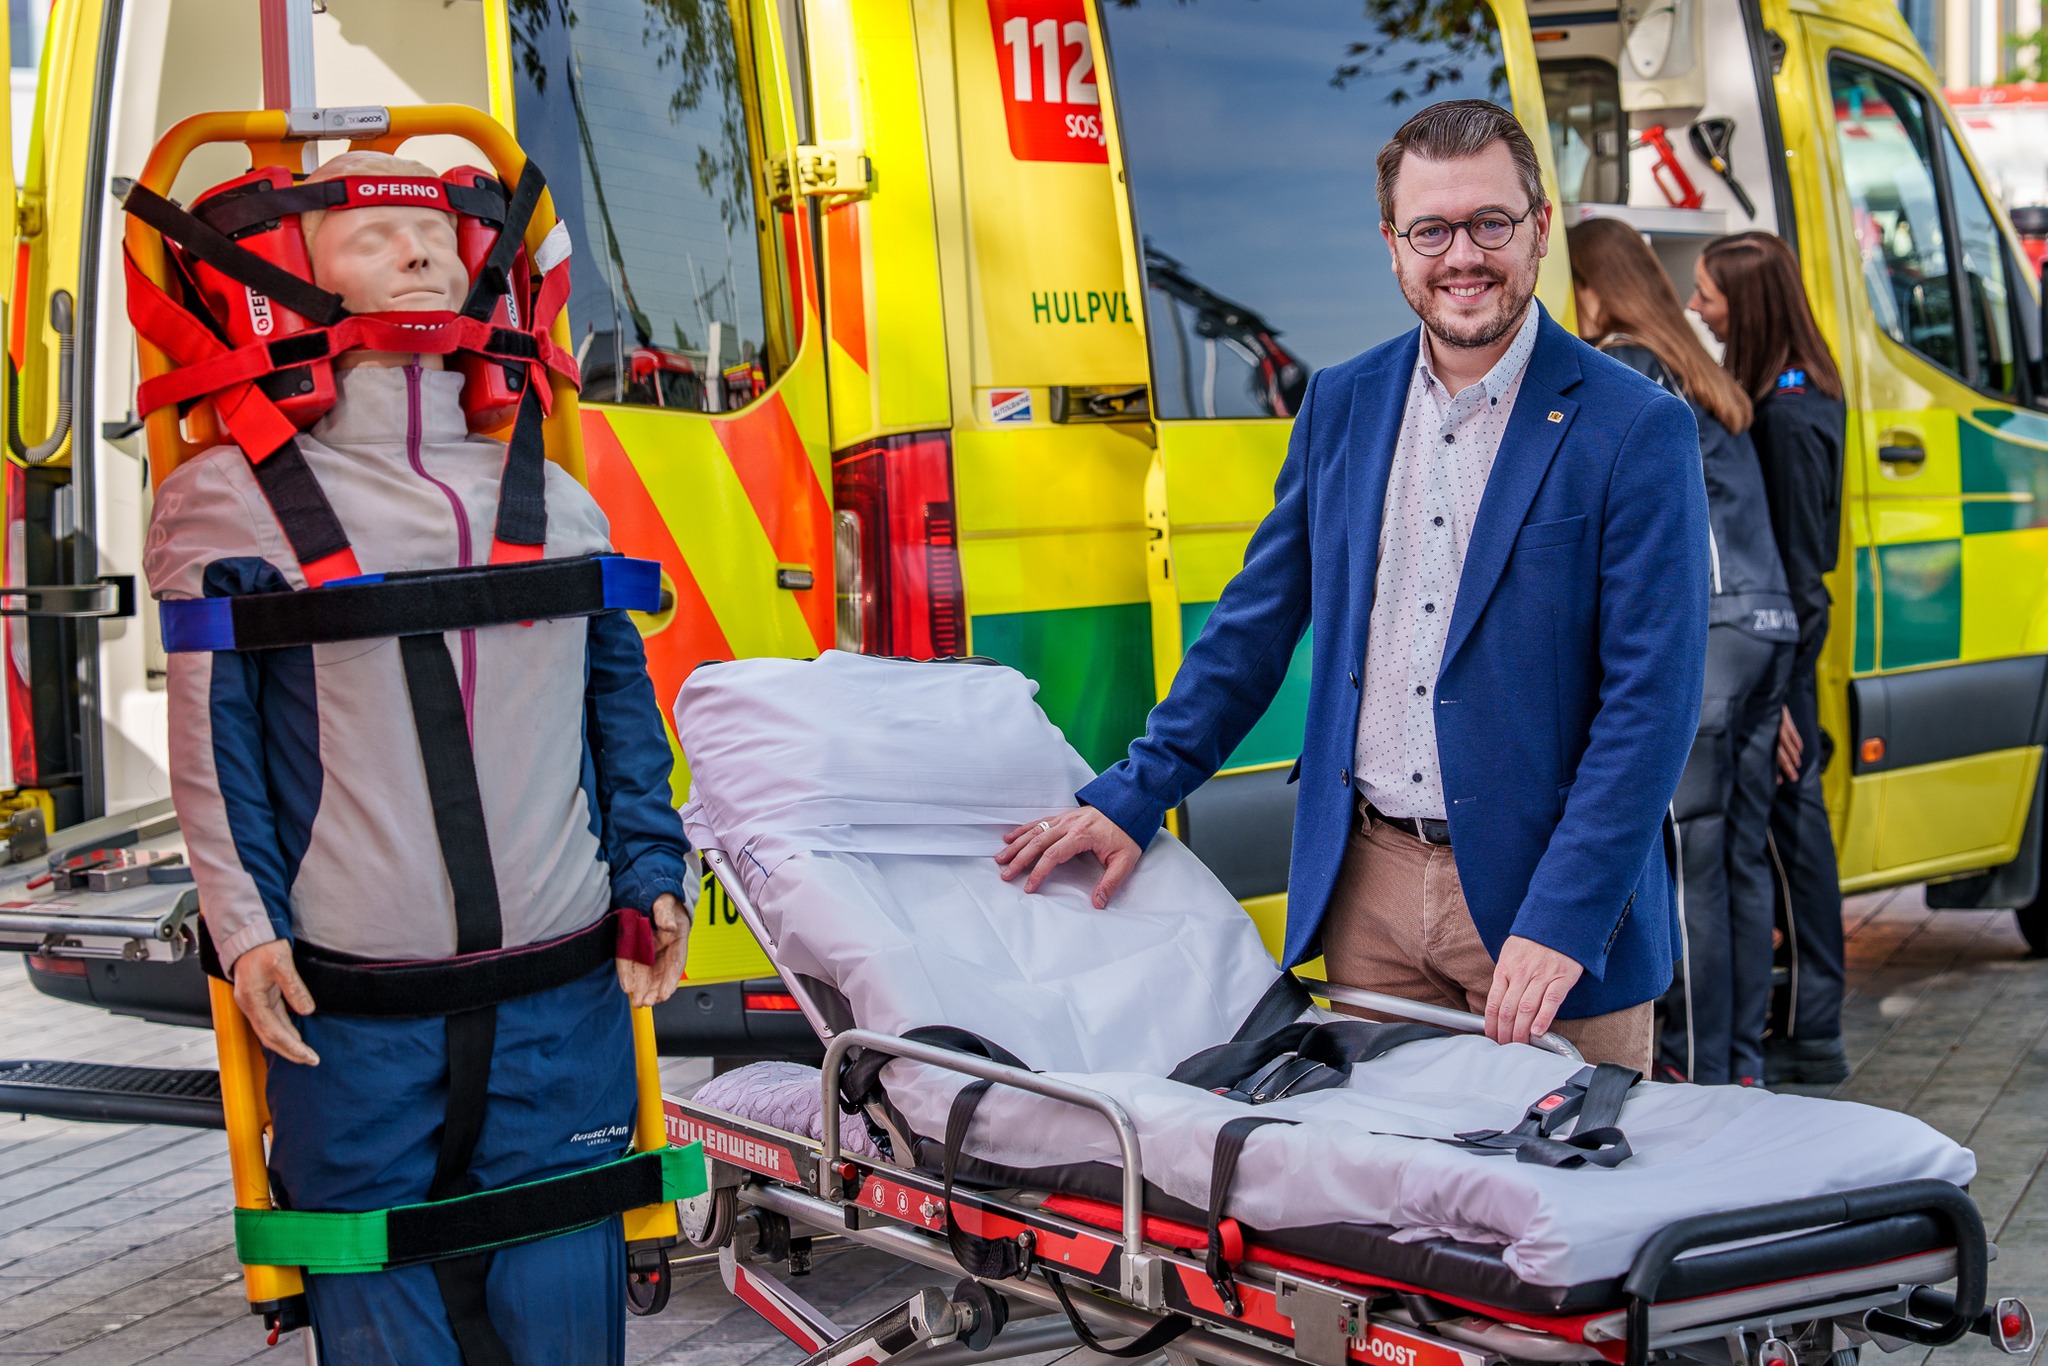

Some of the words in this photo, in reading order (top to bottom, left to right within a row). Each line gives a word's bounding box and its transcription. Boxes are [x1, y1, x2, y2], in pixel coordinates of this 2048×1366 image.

[1003, 16, 1099, 105] 112
[1065, 113, 1099, 139] SOS
[377, 183, 439, 199] FERNO
